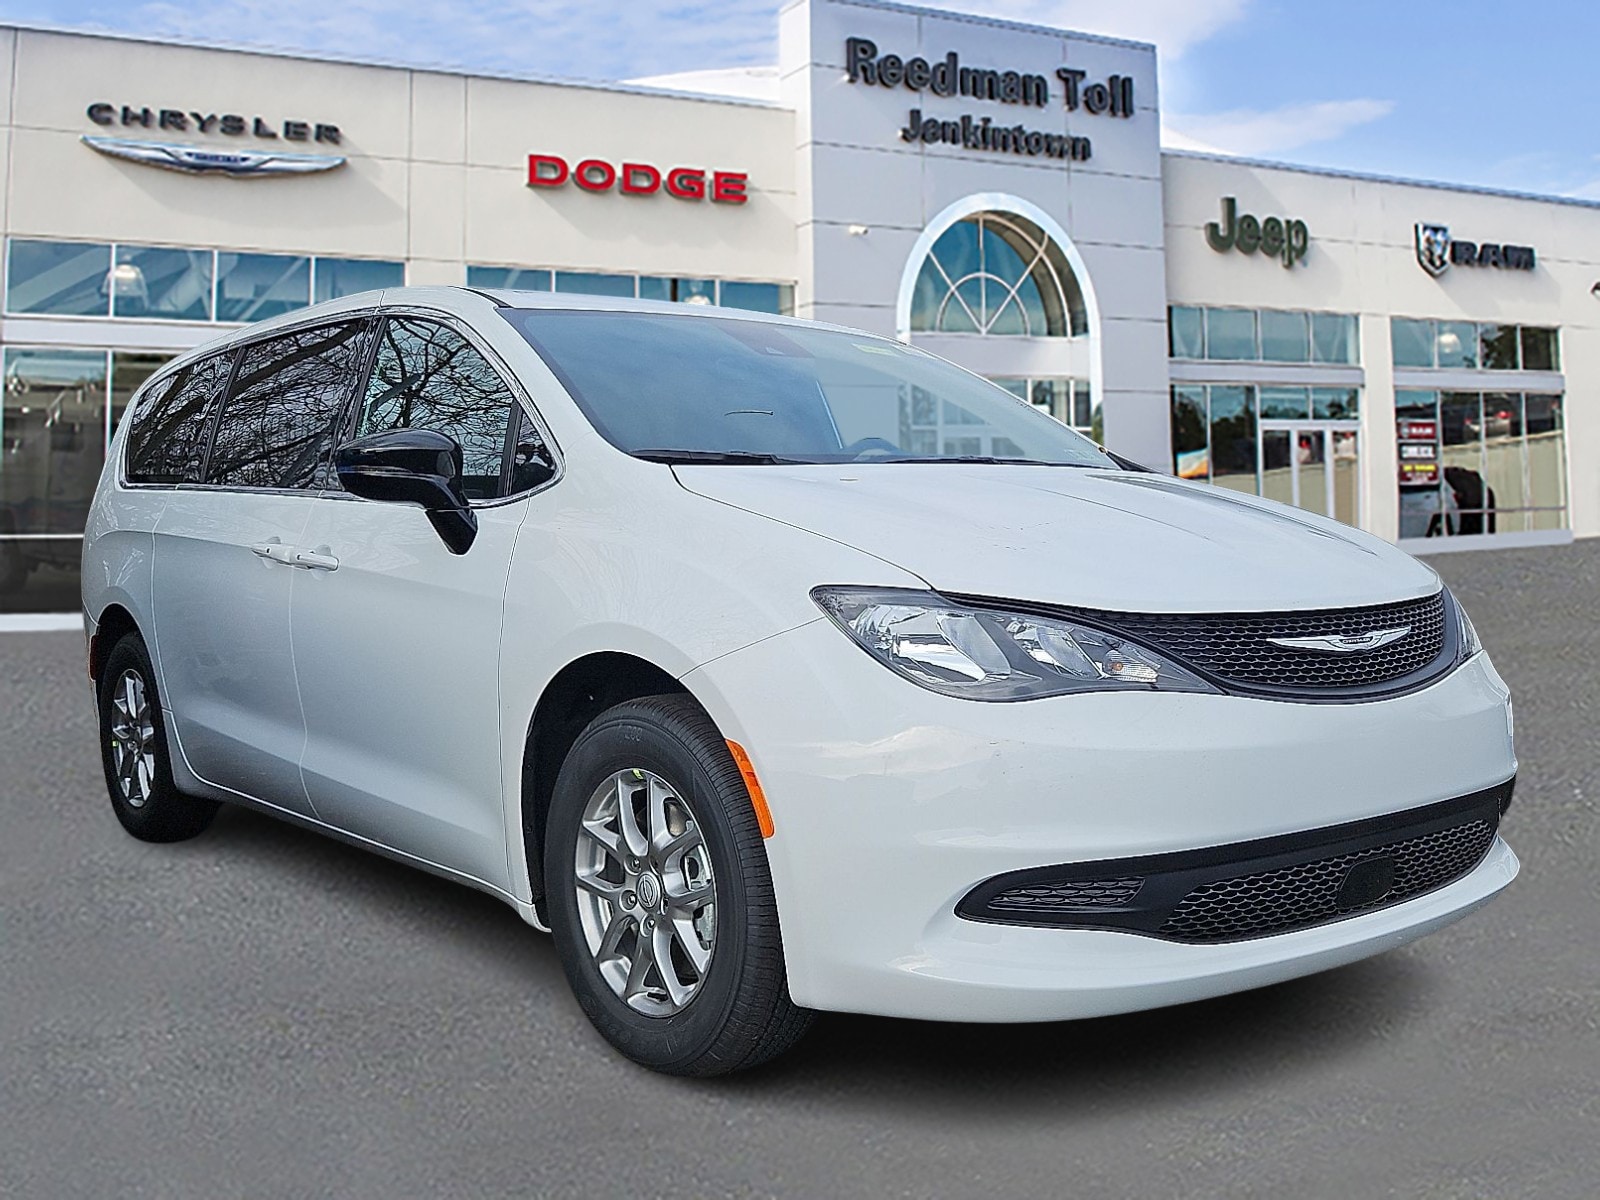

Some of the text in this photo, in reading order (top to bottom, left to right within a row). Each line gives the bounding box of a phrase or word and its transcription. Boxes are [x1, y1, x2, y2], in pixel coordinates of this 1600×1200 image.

[846, 37, 1135, 118] Reedman Toll
[87, 102, 341, 145] CHRYSLER
[900, 108, 1092, 161] Jenkintown
[527, 153, 748, 204] DODGE
[1204, 196, 1308, 270] Jeep
[1451, 240, 1535, 271] RAM
